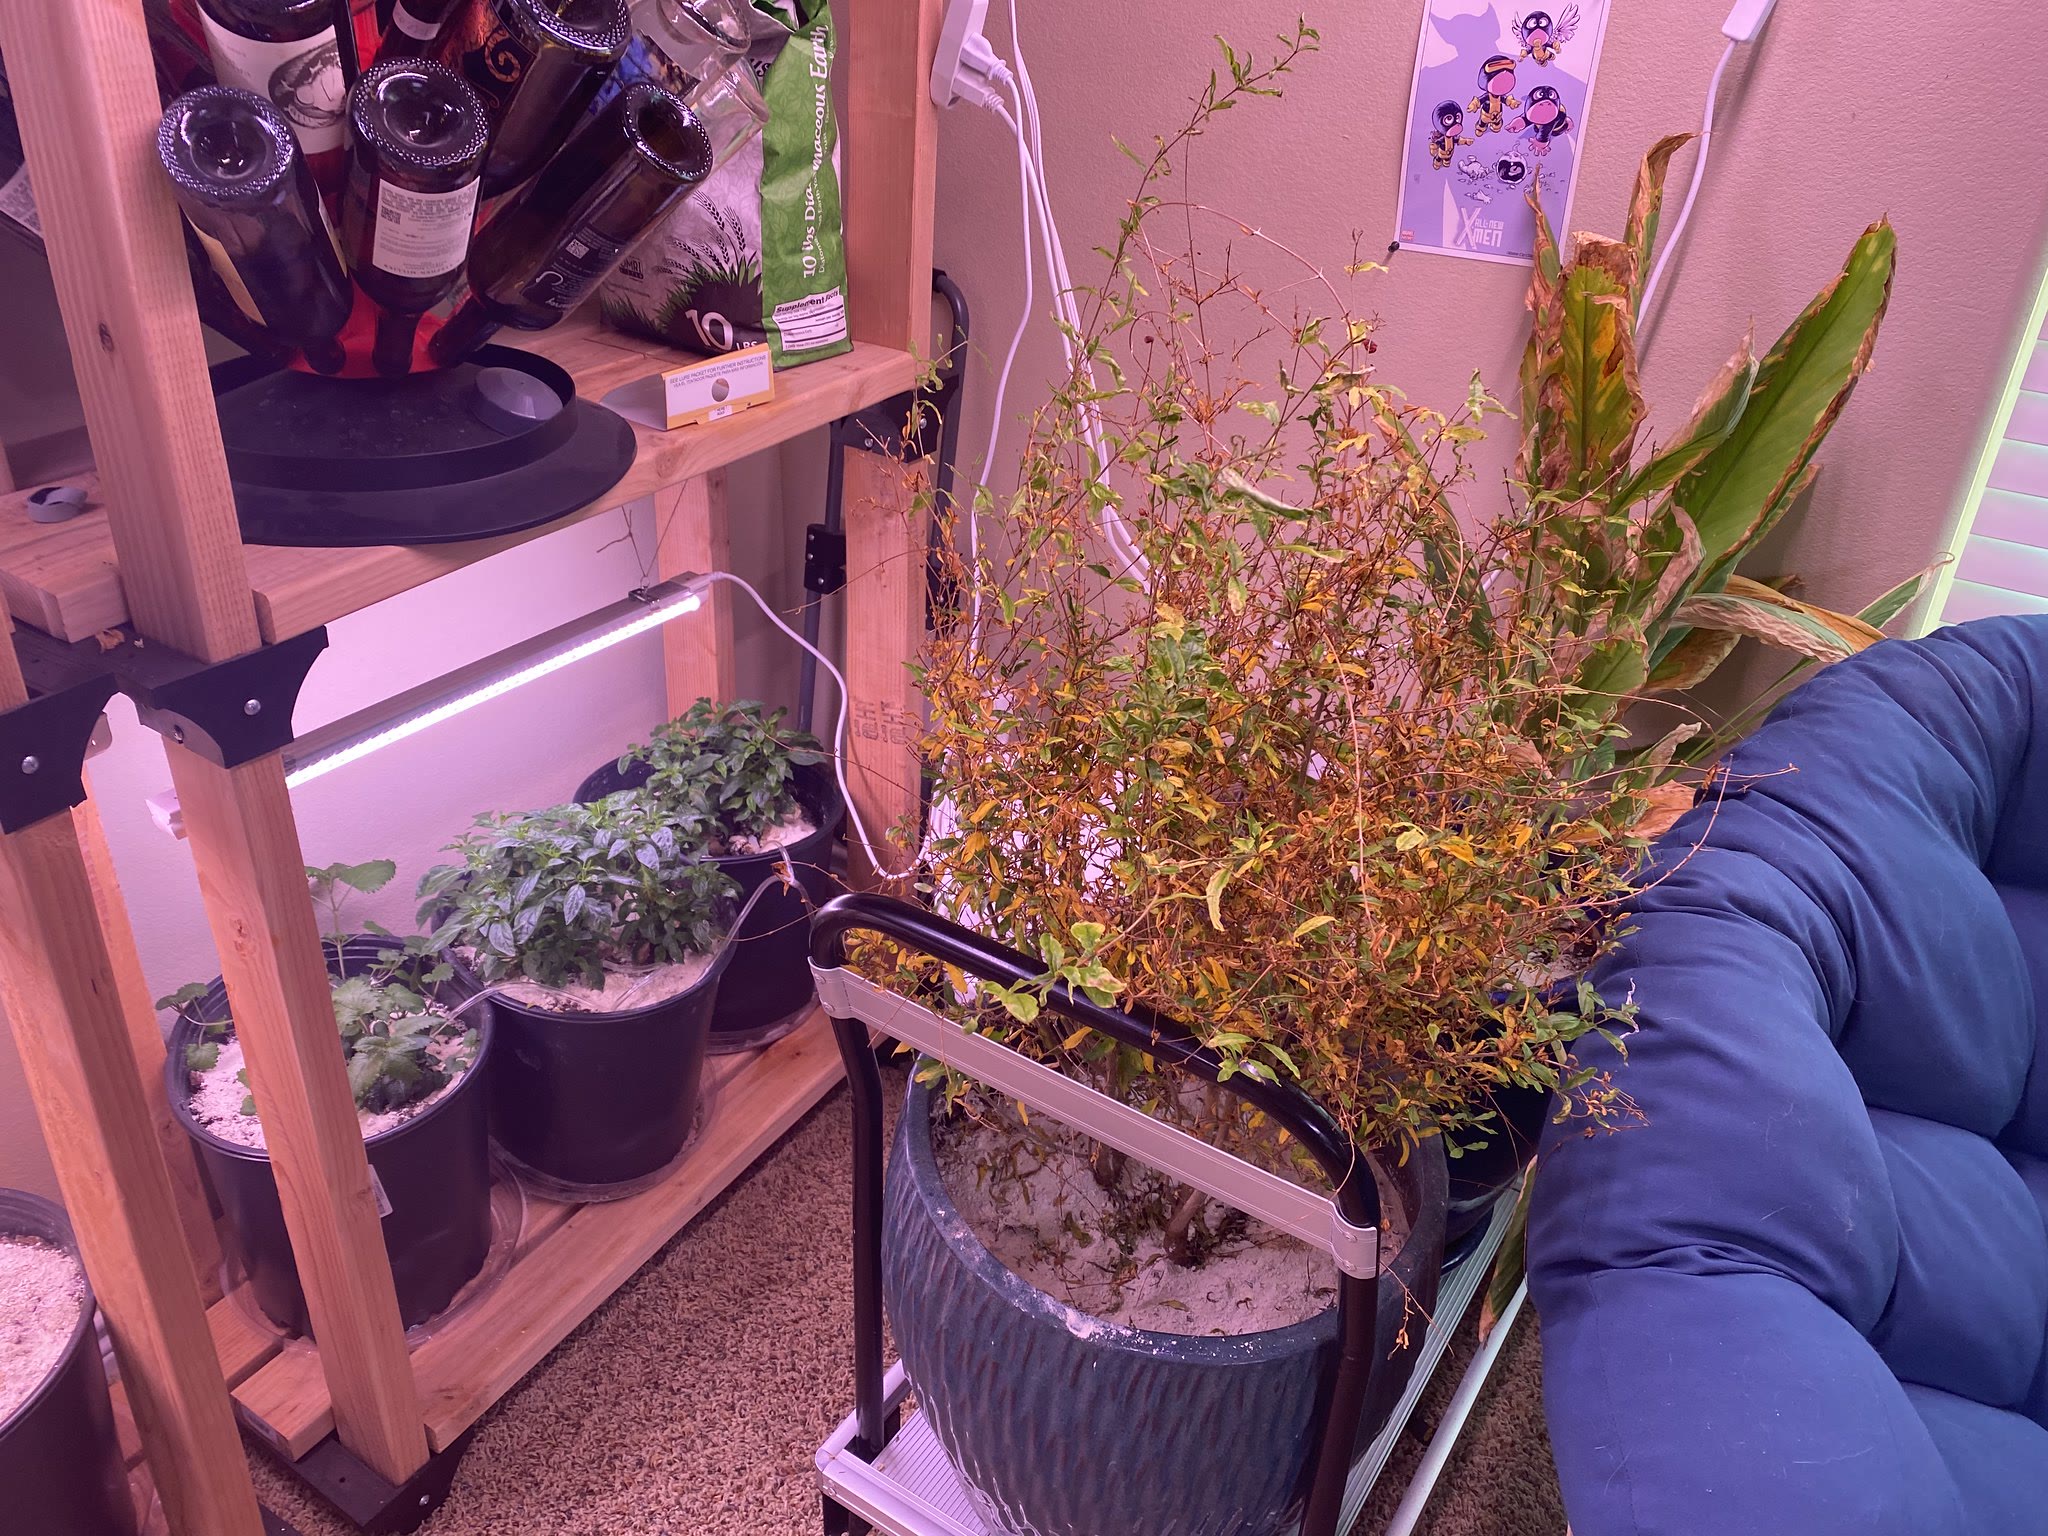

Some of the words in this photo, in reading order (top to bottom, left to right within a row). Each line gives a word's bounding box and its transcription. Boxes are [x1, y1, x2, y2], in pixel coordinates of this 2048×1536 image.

[809, 25, 829, 80] Earth
[803, 255, 817, 279] 10
[776, 296, 825, 312] Supplement
[684, 309, 734, 351] 10
[691, 369, 707, 378] PACKET
[707, 366, 717, 374] FOR
[717, 362, 736, 371] FURTHER
[737, 355, 767, 366] INSTRUCTIONS
